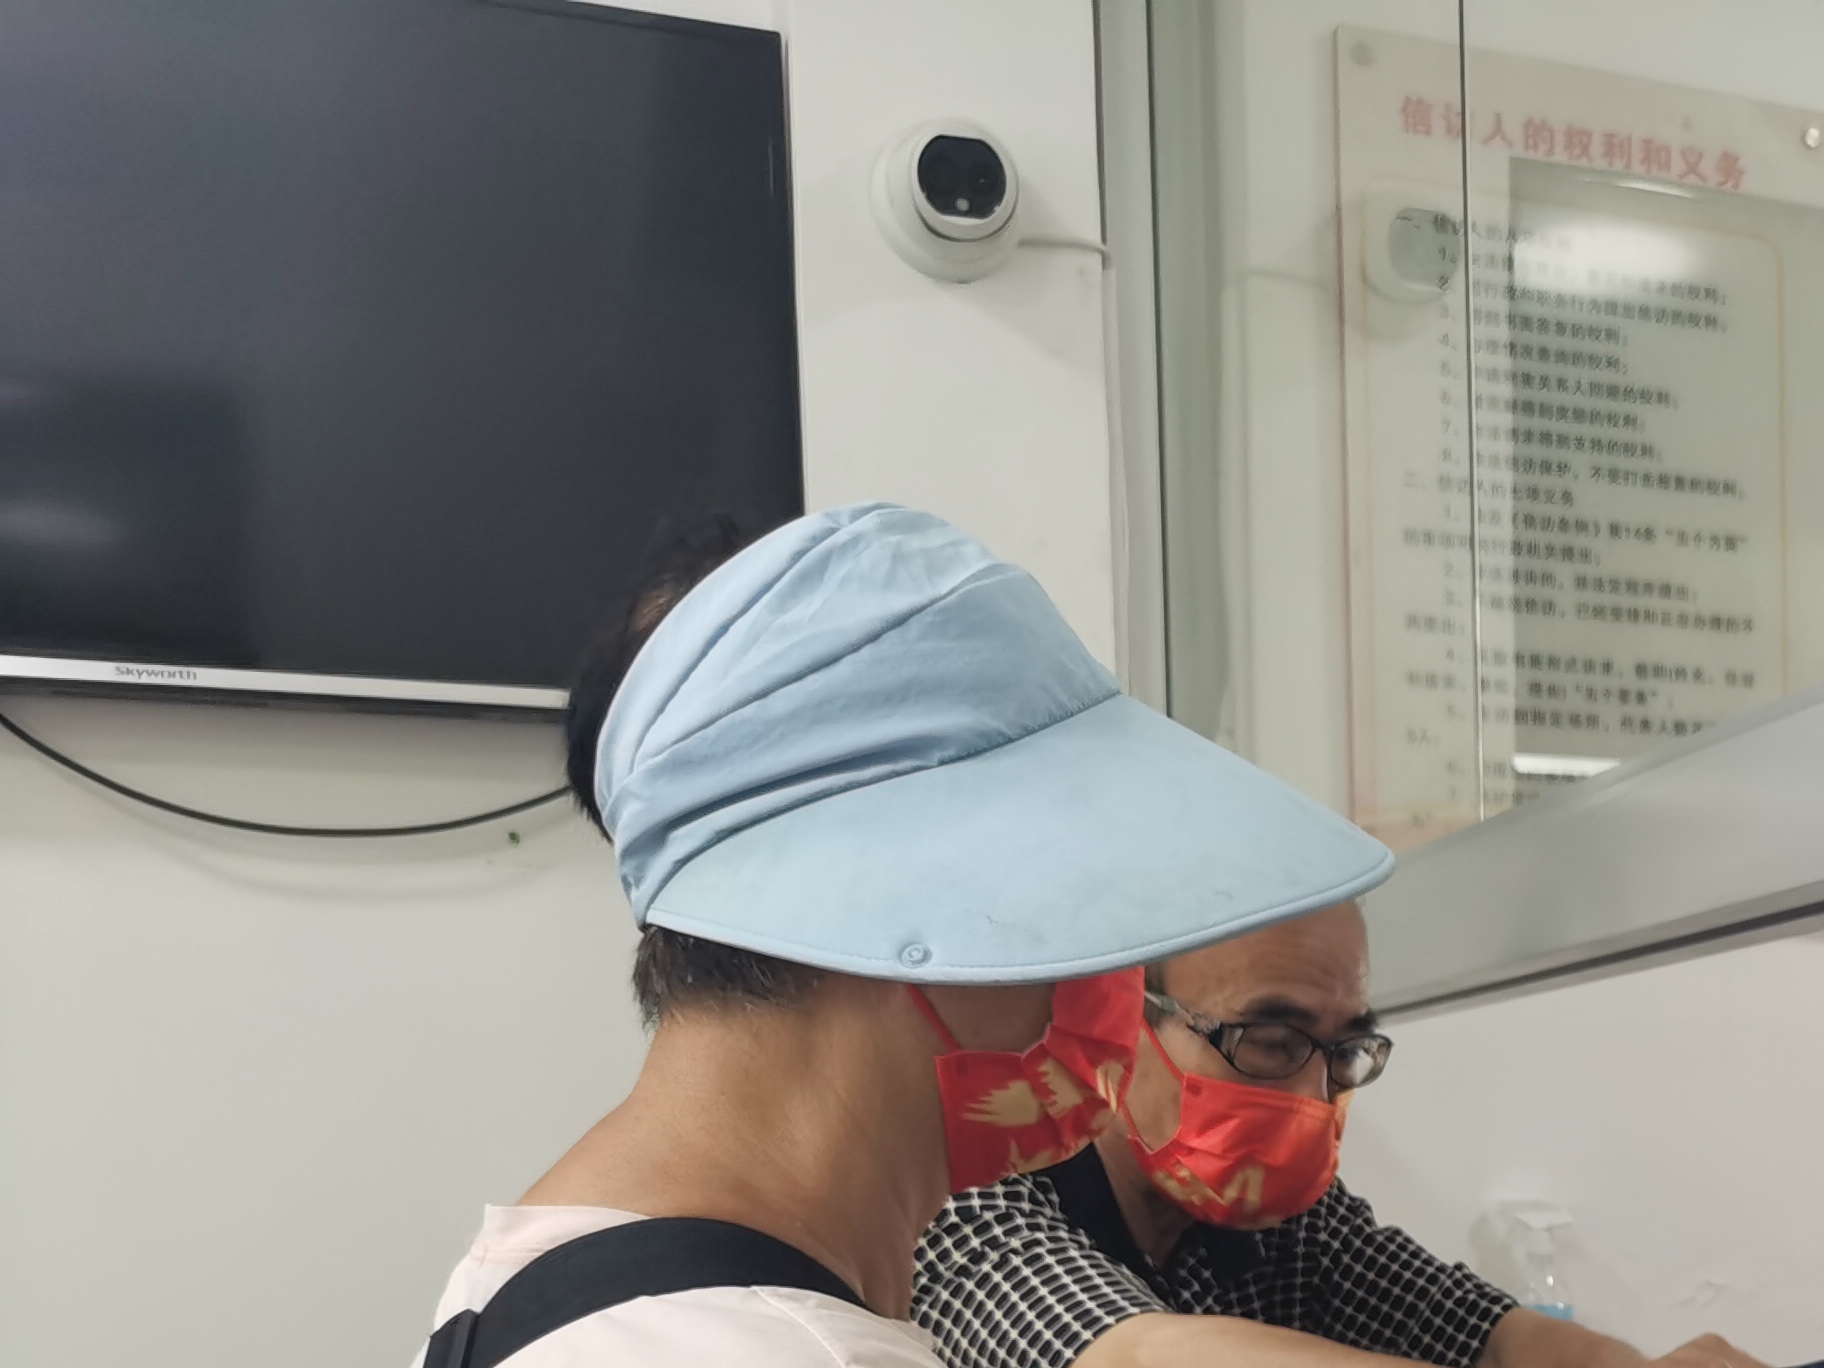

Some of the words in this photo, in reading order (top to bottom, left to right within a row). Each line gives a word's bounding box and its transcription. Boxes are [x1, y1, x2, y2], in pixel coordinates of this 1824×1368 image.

[1400, 94, 1748, 192] 信访人的权利和义务
[115, 665, 198, 681] Skyworth
